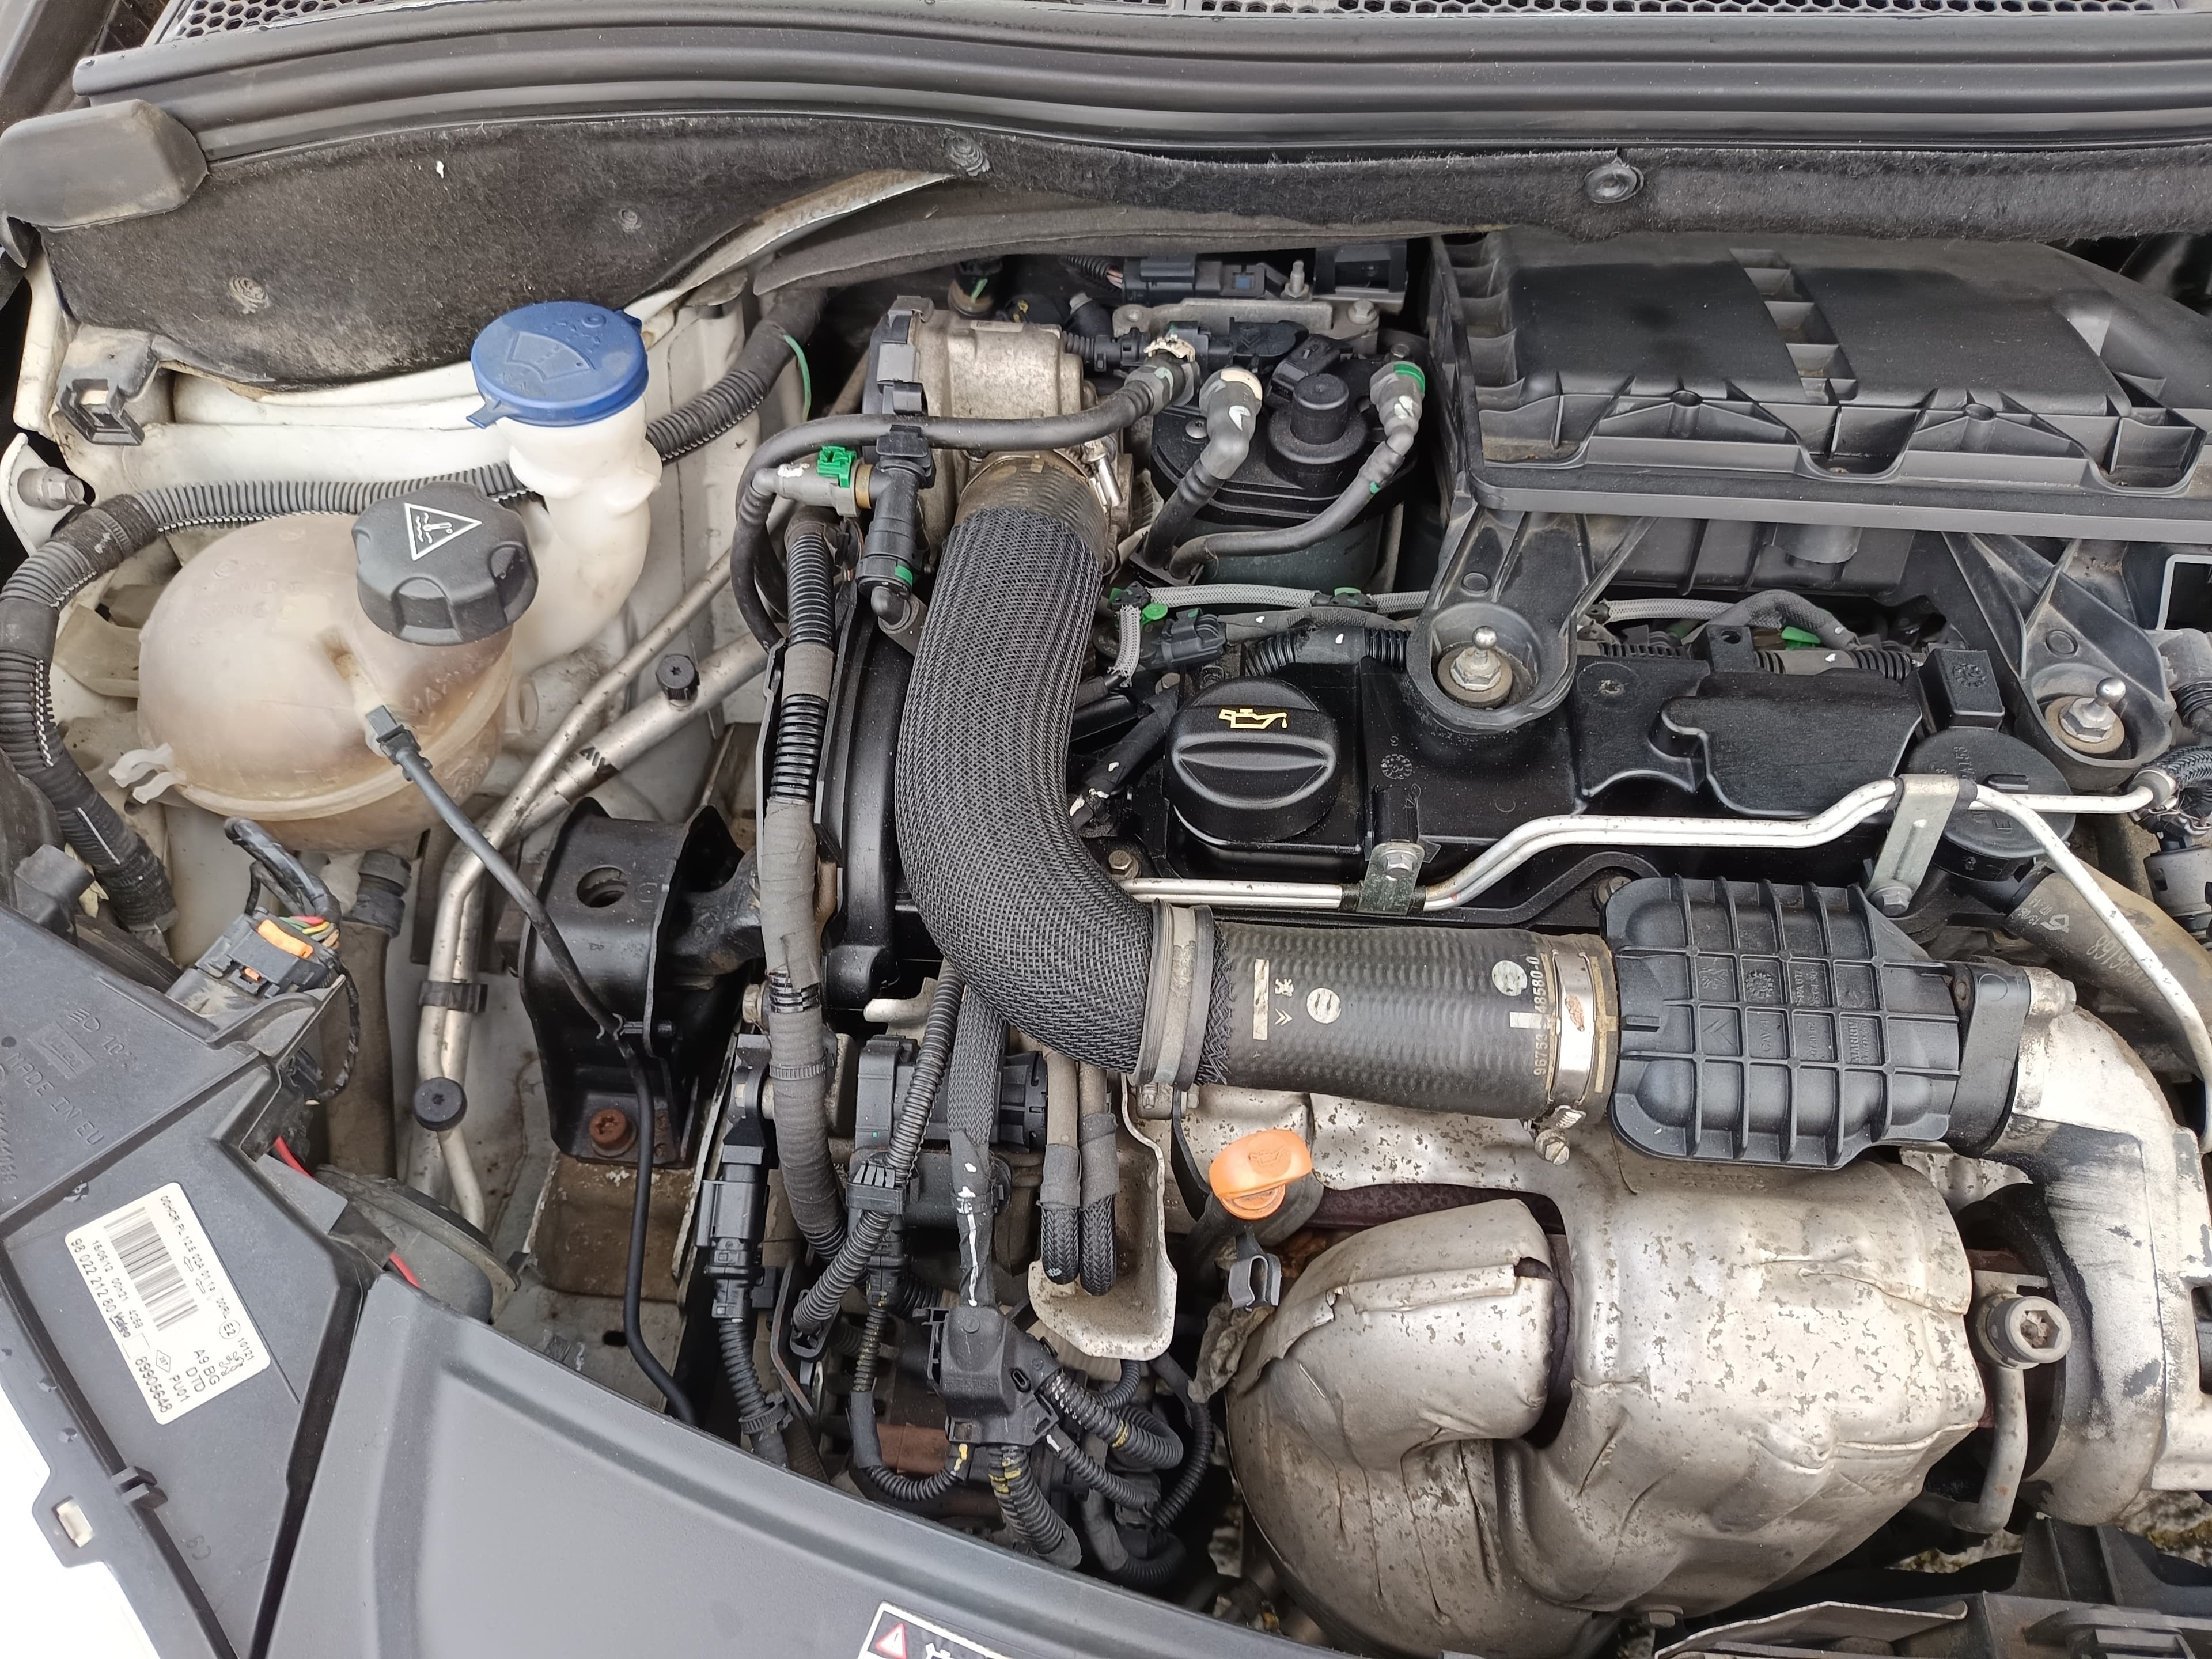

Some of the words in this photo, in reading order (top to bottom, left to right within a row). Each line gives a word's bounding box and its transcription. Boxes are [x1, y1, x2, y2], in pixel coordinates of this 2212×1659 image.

[6, 1052, 56, 1097] MADE
[50, 1096, 83, 1124] IN
[74, 1120, 105, 1146] EU
[78, 1252, 98, 1275] 022
[89, 1275, 109, 1298] 212
[222, 1322, 237, 1336] E2
[237, 1336, 255, 1361] 10121
[184, 1365, 207, 1394] DTD
[193, 1346, 210, 1365] A9
[202, 1364, 222, 1387] BG
[168, 1373, 191, 1403] PU01
